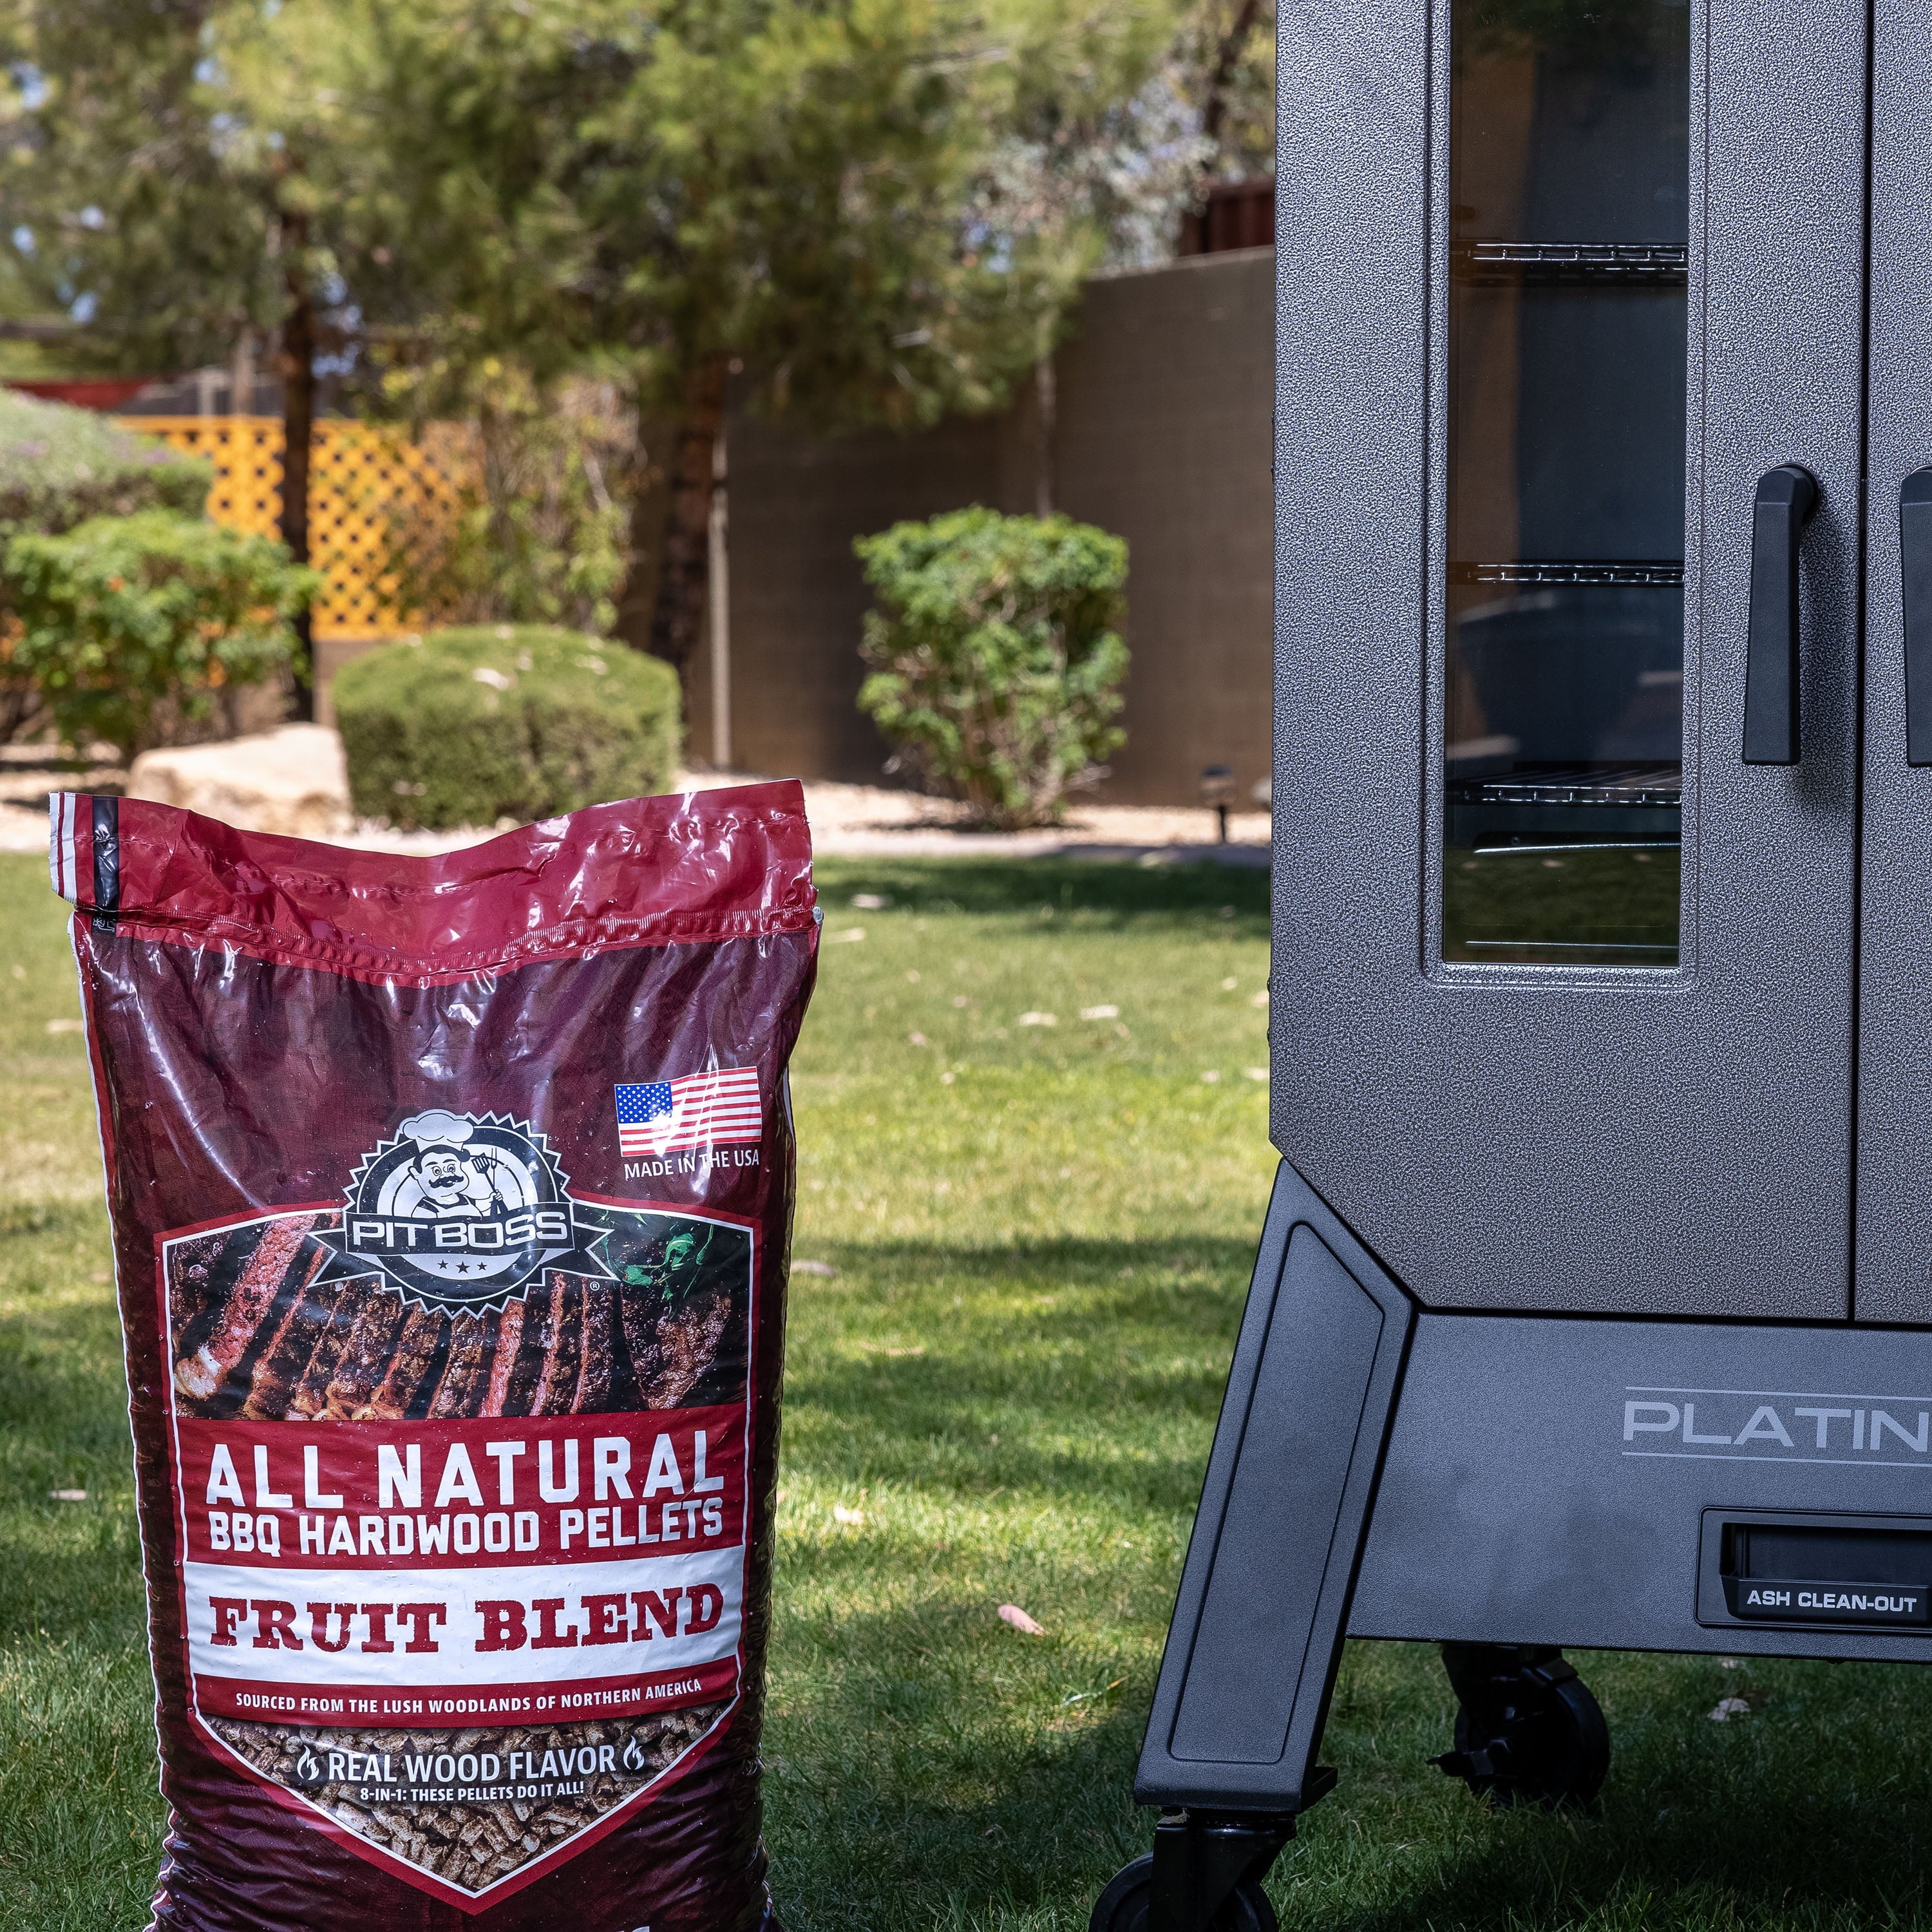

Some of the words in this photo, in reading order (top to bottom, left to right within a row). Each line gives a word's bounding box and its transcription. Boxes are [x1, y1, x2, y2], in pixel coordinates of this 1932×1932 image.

[624, 1160, 674, 1179] MADE
[678, 1156, 696, 1173] IN
[699, 1151, 730, 1170] THE
[735, 1149, 759, 1166] USA
[354, 1221, 428, 1247] PIT
[435, 1212, 567, 1248] BOSS
[1623, 1401, 1929, 1452] PLATIN
[206, 1444, 343, 1508] ALL
[378, 1430, 724, 1508] NATURAL
[208, 1511, 280, 1557] BBQ
[299, 1511, 540, 1555] HARDWOOD
[560, 1497, 723, 1549] PELLETS
[209, 1596, 447, 1653] FRUIT
[474, 1583, 724, 1653] BLEND
[1747, 1590, 1790, 1606] ASH
[1797, 1592, 1917, 1612] CLEAN-OUT
[236, 1692, 296, 1710] SOURCED
[301, 1698, 344, 1712] FROM
[349, 1699, 378, 1713] THE
[383, 1700, 423, 1714] LUSH
[428, 1697, 531, 1713] WOODLANDS
[536, 1696, 556, 1709] OF
[561, 1687, 641, 1709] NORTHERN
[645, 1678, 702, 1700] AMERICA
[328, 1752, 397, 1782] REAL
[404, 1754, 500, 1783] WOOD
[510, 1745, 616, 1780] FLAVOR
[360, 1787, 407, 1801] 8-IN-1:
[411, 1788, 453, 1802] THESE
[458, 1786, 514, 1801] PELLETS
[517, 1785, 536, 1799] DO
[541, 1784, 552, 1796] IT
[556, 1781, 585, 1795] ALL!
